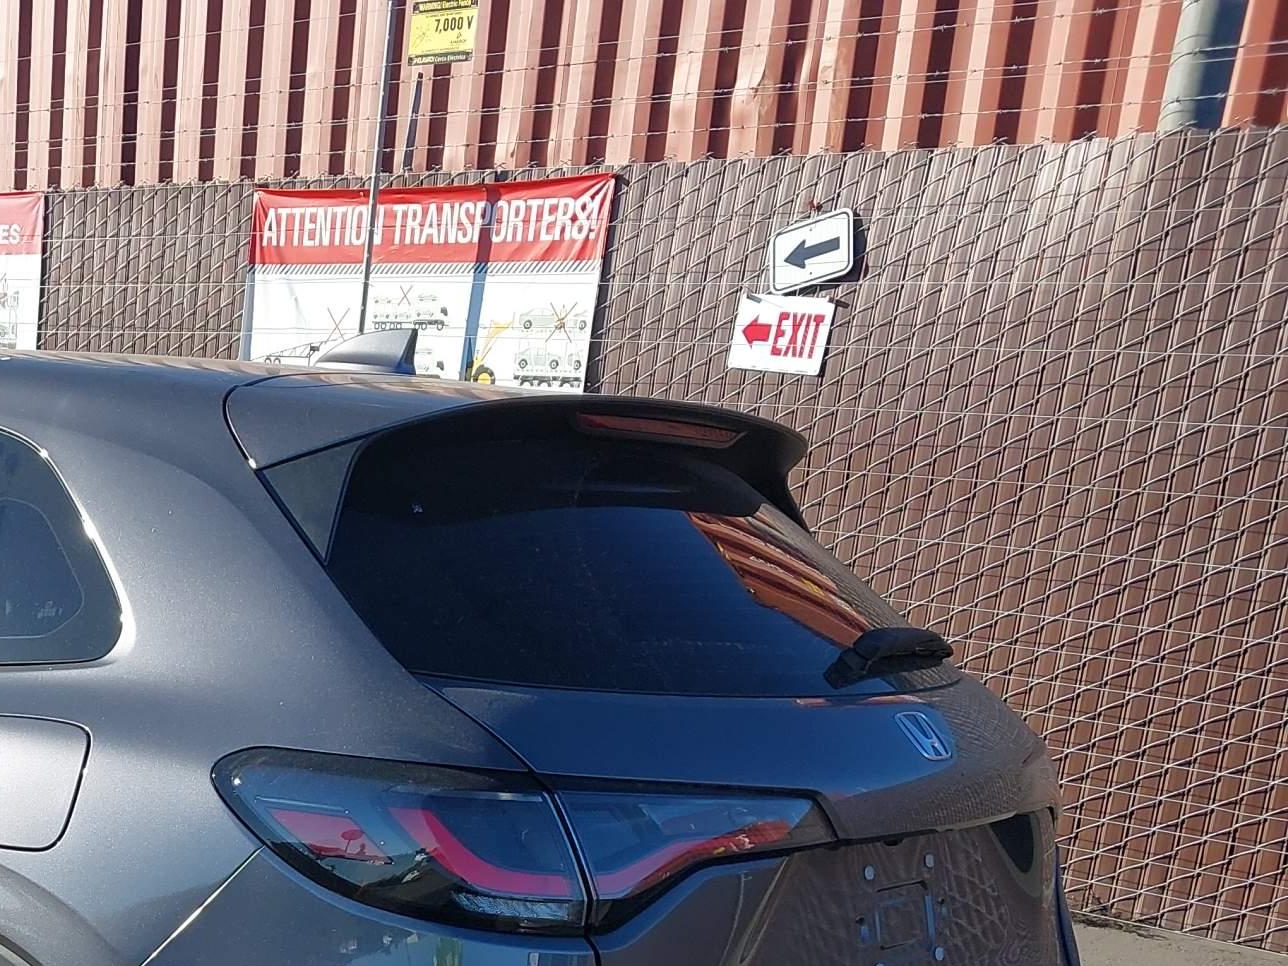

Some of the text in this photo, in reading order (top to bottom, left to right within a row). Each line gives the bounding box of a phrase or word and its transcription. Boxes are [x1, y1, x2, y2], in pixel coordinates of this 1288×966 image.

[435, 16, 474, 34] 7,000 V
[261, 195, 602, 247] ATTENTION TRANSPORTERS!
[770, 312, 825, 359] EXIT
